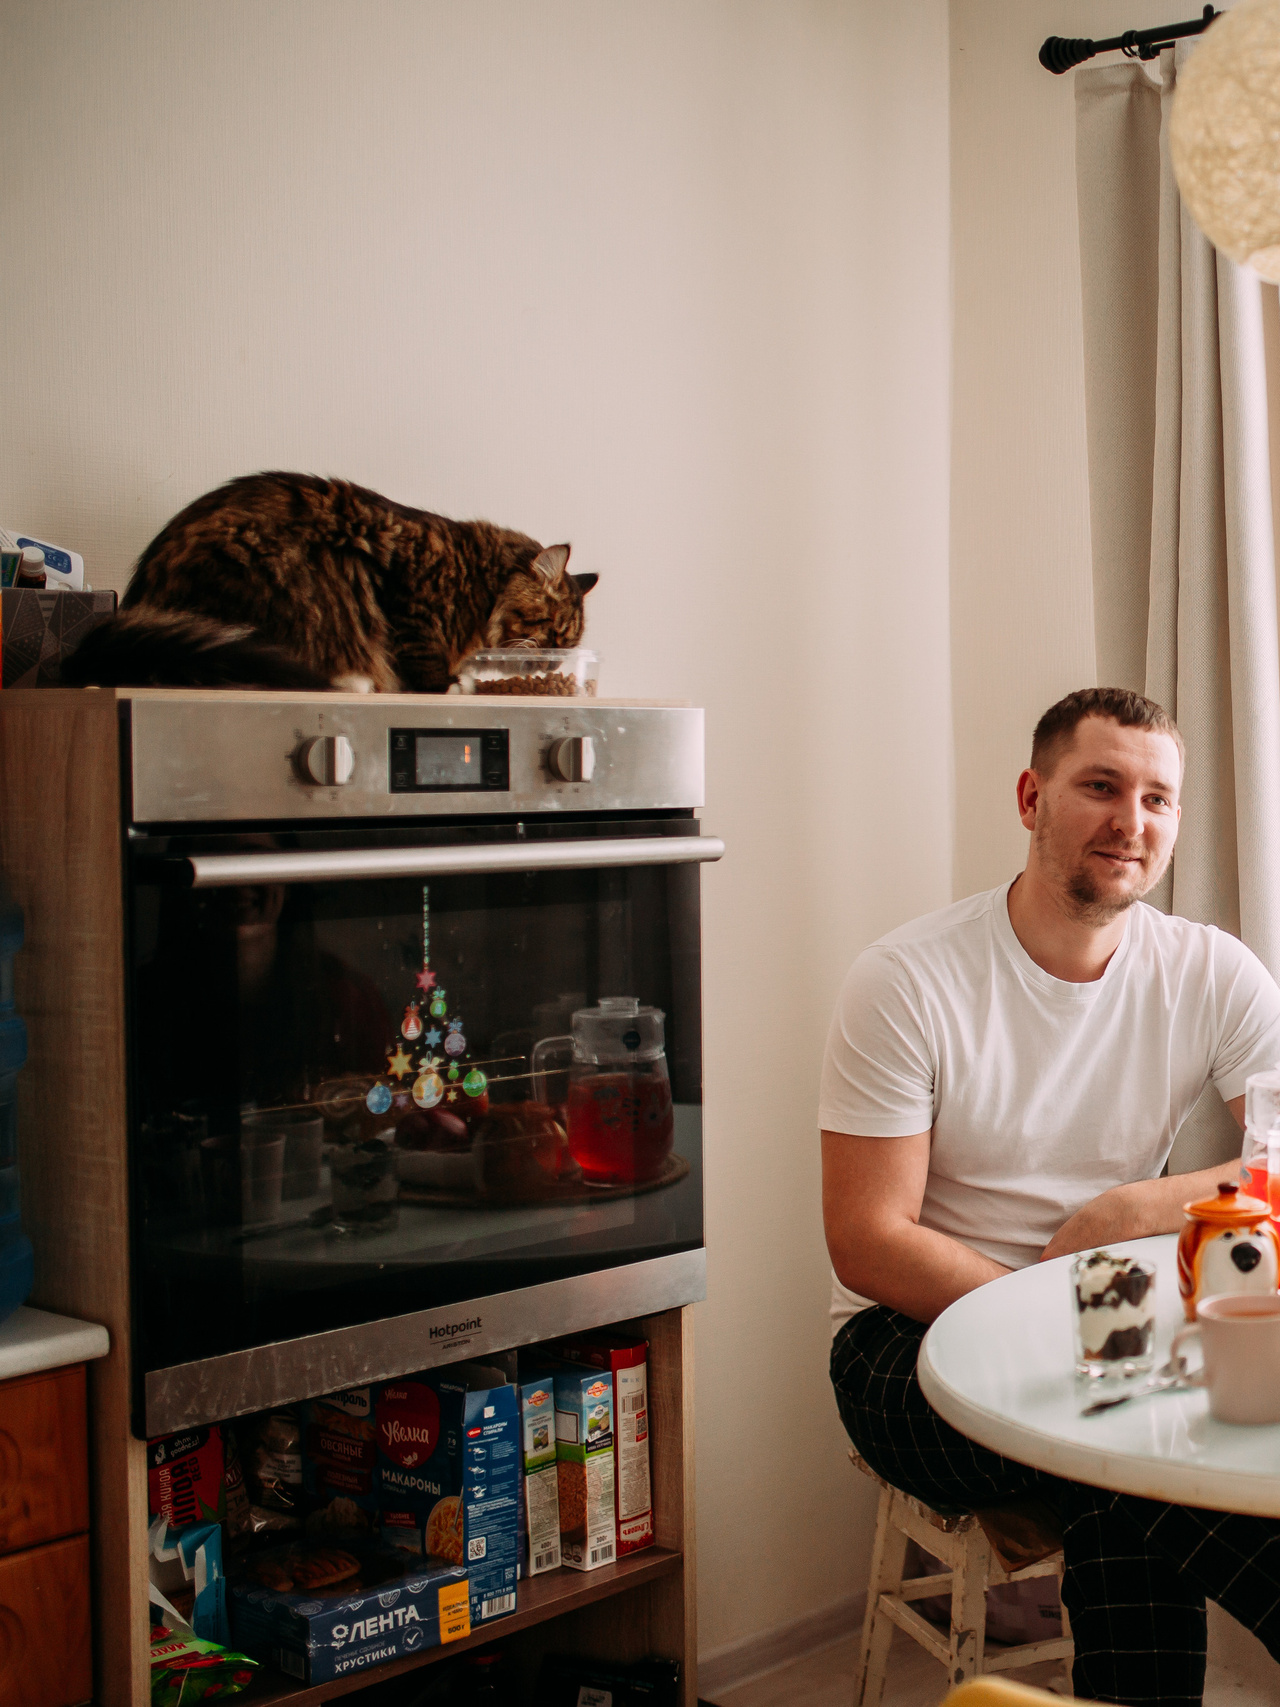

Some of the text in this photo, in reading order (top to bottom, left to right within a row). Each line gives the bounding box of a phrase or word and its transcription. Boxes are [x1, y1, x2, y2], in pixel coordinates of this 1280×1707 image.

[429, 1316, 482, 1339] Hotpoint
[442, 1339, 471, 1350] ARISTON
[381, 1419, 430, 1446] Увелка
[320, 1438, 363, 1459] ОВСЯНЫЕ
[188, 1457, 202, 1482] RED
[381, 1468, 441, 1497] МАКАРОНЫ
[447, 1624, 461, 1634] 500
[334, 1645, 397, 1674] ХРУСТИКИ
